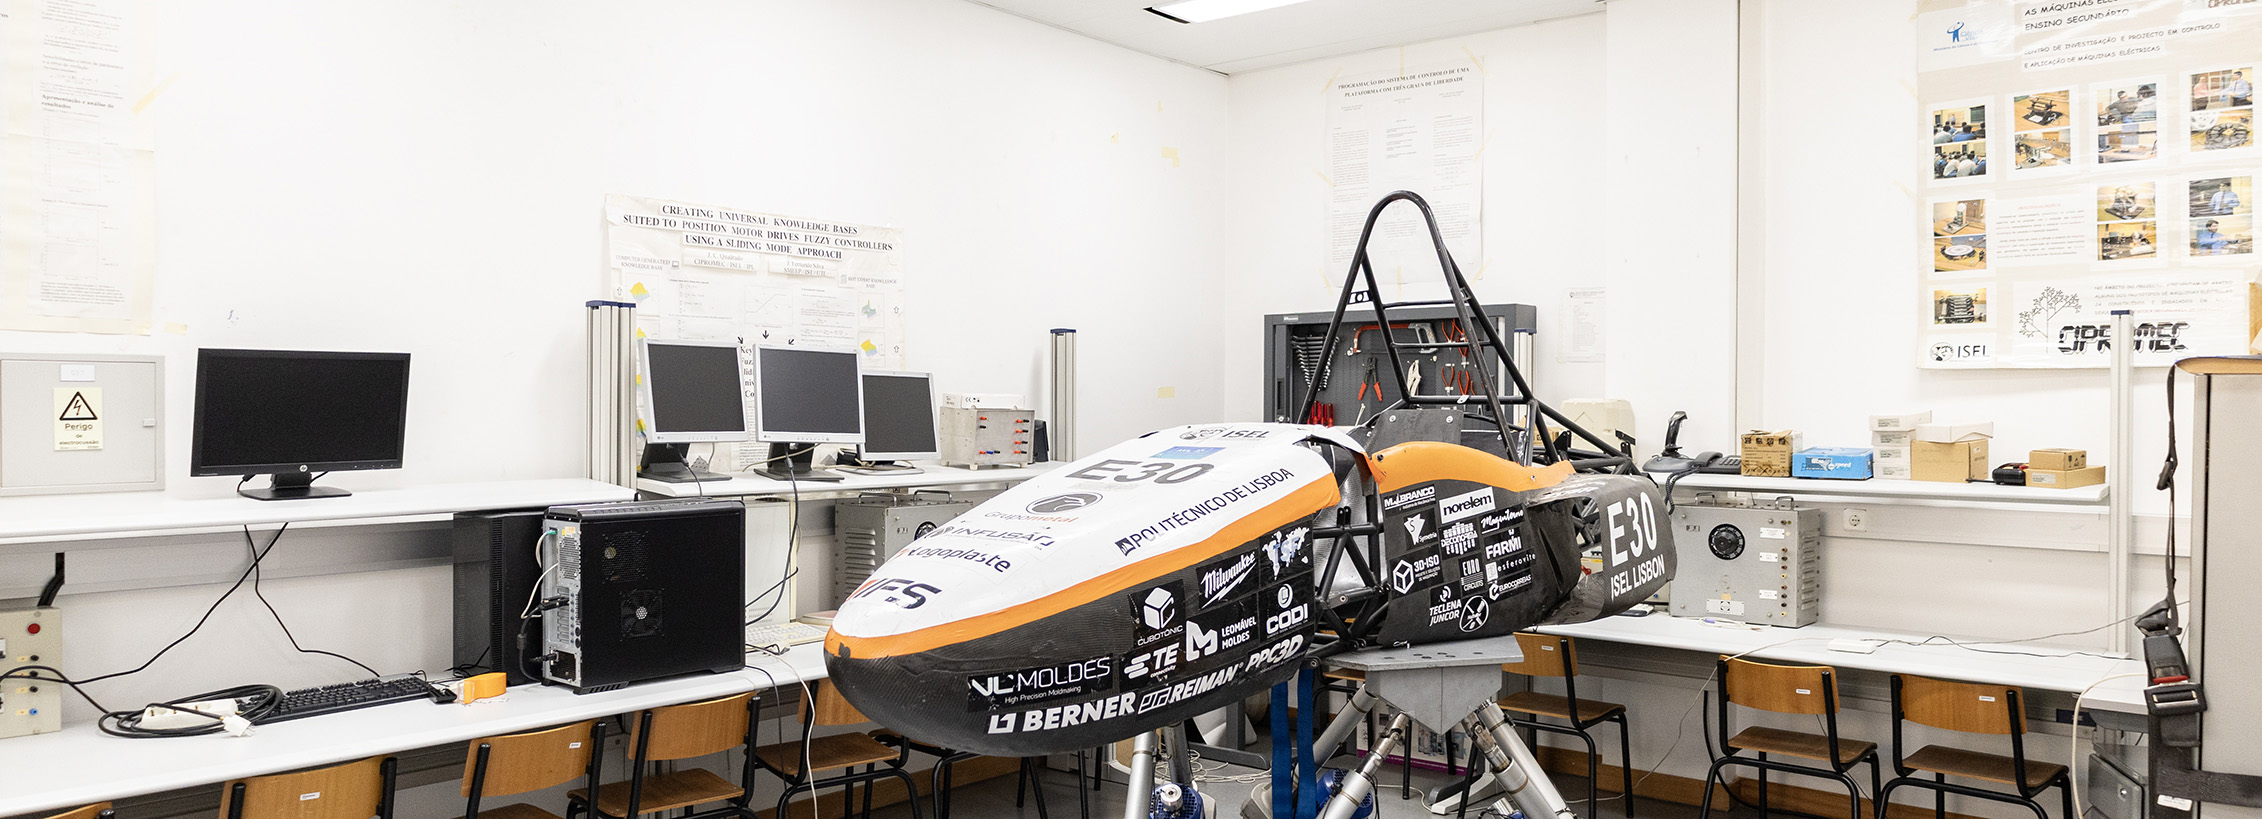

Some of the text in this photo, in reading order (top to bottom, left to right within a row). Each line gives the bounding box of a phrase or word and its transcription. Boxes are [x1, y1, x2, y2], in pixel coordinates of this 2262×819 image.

[2024, 8, 2037, 16] AS
[2041, 0, 2094, 14] MÁQUINAS
[2025, 19, 2063, 31] ENSINO
[2053, 44, 2061, 52] DE
[2065, 36, 2117, 50] INVESTIGAÇÃO
[2128, 30, 2164, 41] PROJECTO
[2182, 22, 2221, 34] CONTROLO
[2030, 56, 2065, 68] APLICAÇÃO
[2077, 50, 2116, 62] MÁQUINAS
[2119, 44, 2161, 57] ELÉCTRICAS
[1337, 79, 1377, 90] PROGRAMAÇÃO
[1378, 78, 1386, 86] DO
[1386, 75, 1409, 84] SISTEMA
[1417, 69, 1447, 79] CONTROLO
[1457, 66, 1470, 74] UMA
[1344, 89, 1379, 97] PLATAFORMA
[1379, 86, 1392, 94] COM
[1393, 83, 1406, 92] TRÊS
[1406, 81, 1425, 90] GRAUS
[1433, 76, 1464, 86] LIBERDADE
[662, 204, 858, 235] CREATING UNIVERSAL KNOWLEDGE BASES
[623, 214, 894, 252] SUITED TO POSITION MOTOR DRIVES FUZZY CONTROLLERS
[685, 234, 843, 260] USING A SLIDING MODE APPROACH
[2058, 321, 2190, 354] CIPRMEC
[64, 423, 93, 431] Perigo
[1222, 429, 1270, 440] ISEL
[1065, 458, 1215, 484] E30
[1129, 468, 1295, 548] POLITÉCNICO DE LISBOA
[1443, 494, 1492, 516] norelem
[1607, 491, 1658, 568] E30
[1413, 554, 1440, 573] 3D-ISO
[1496, 553, 1536, 572] esferovite
[1200, 552, 1256, 599] Milwaukee
[1610, 553, 1666, 603] ISEL LISBON
[1266, 603, 1309, 635] CODI
[1429, 599, 1462, 616] TECLENA
[1429, 609, 1460, 627] JUNCOR
[1221, 616, 1257, 637] LEOMÁVEL
[1221, 630, 1250, 650] MOLDES
[1152, 642, 1180, 670] TE
[1244, 634, 1304, 673] PPC3D
[1017, 656, 1110, 692] MOLDES
[1149, 664, 1177, 679] connectivity
[1004, 685, 1082, 706] High Precision Moldmaking
[1022, 690, 1136, 733] BERNER
